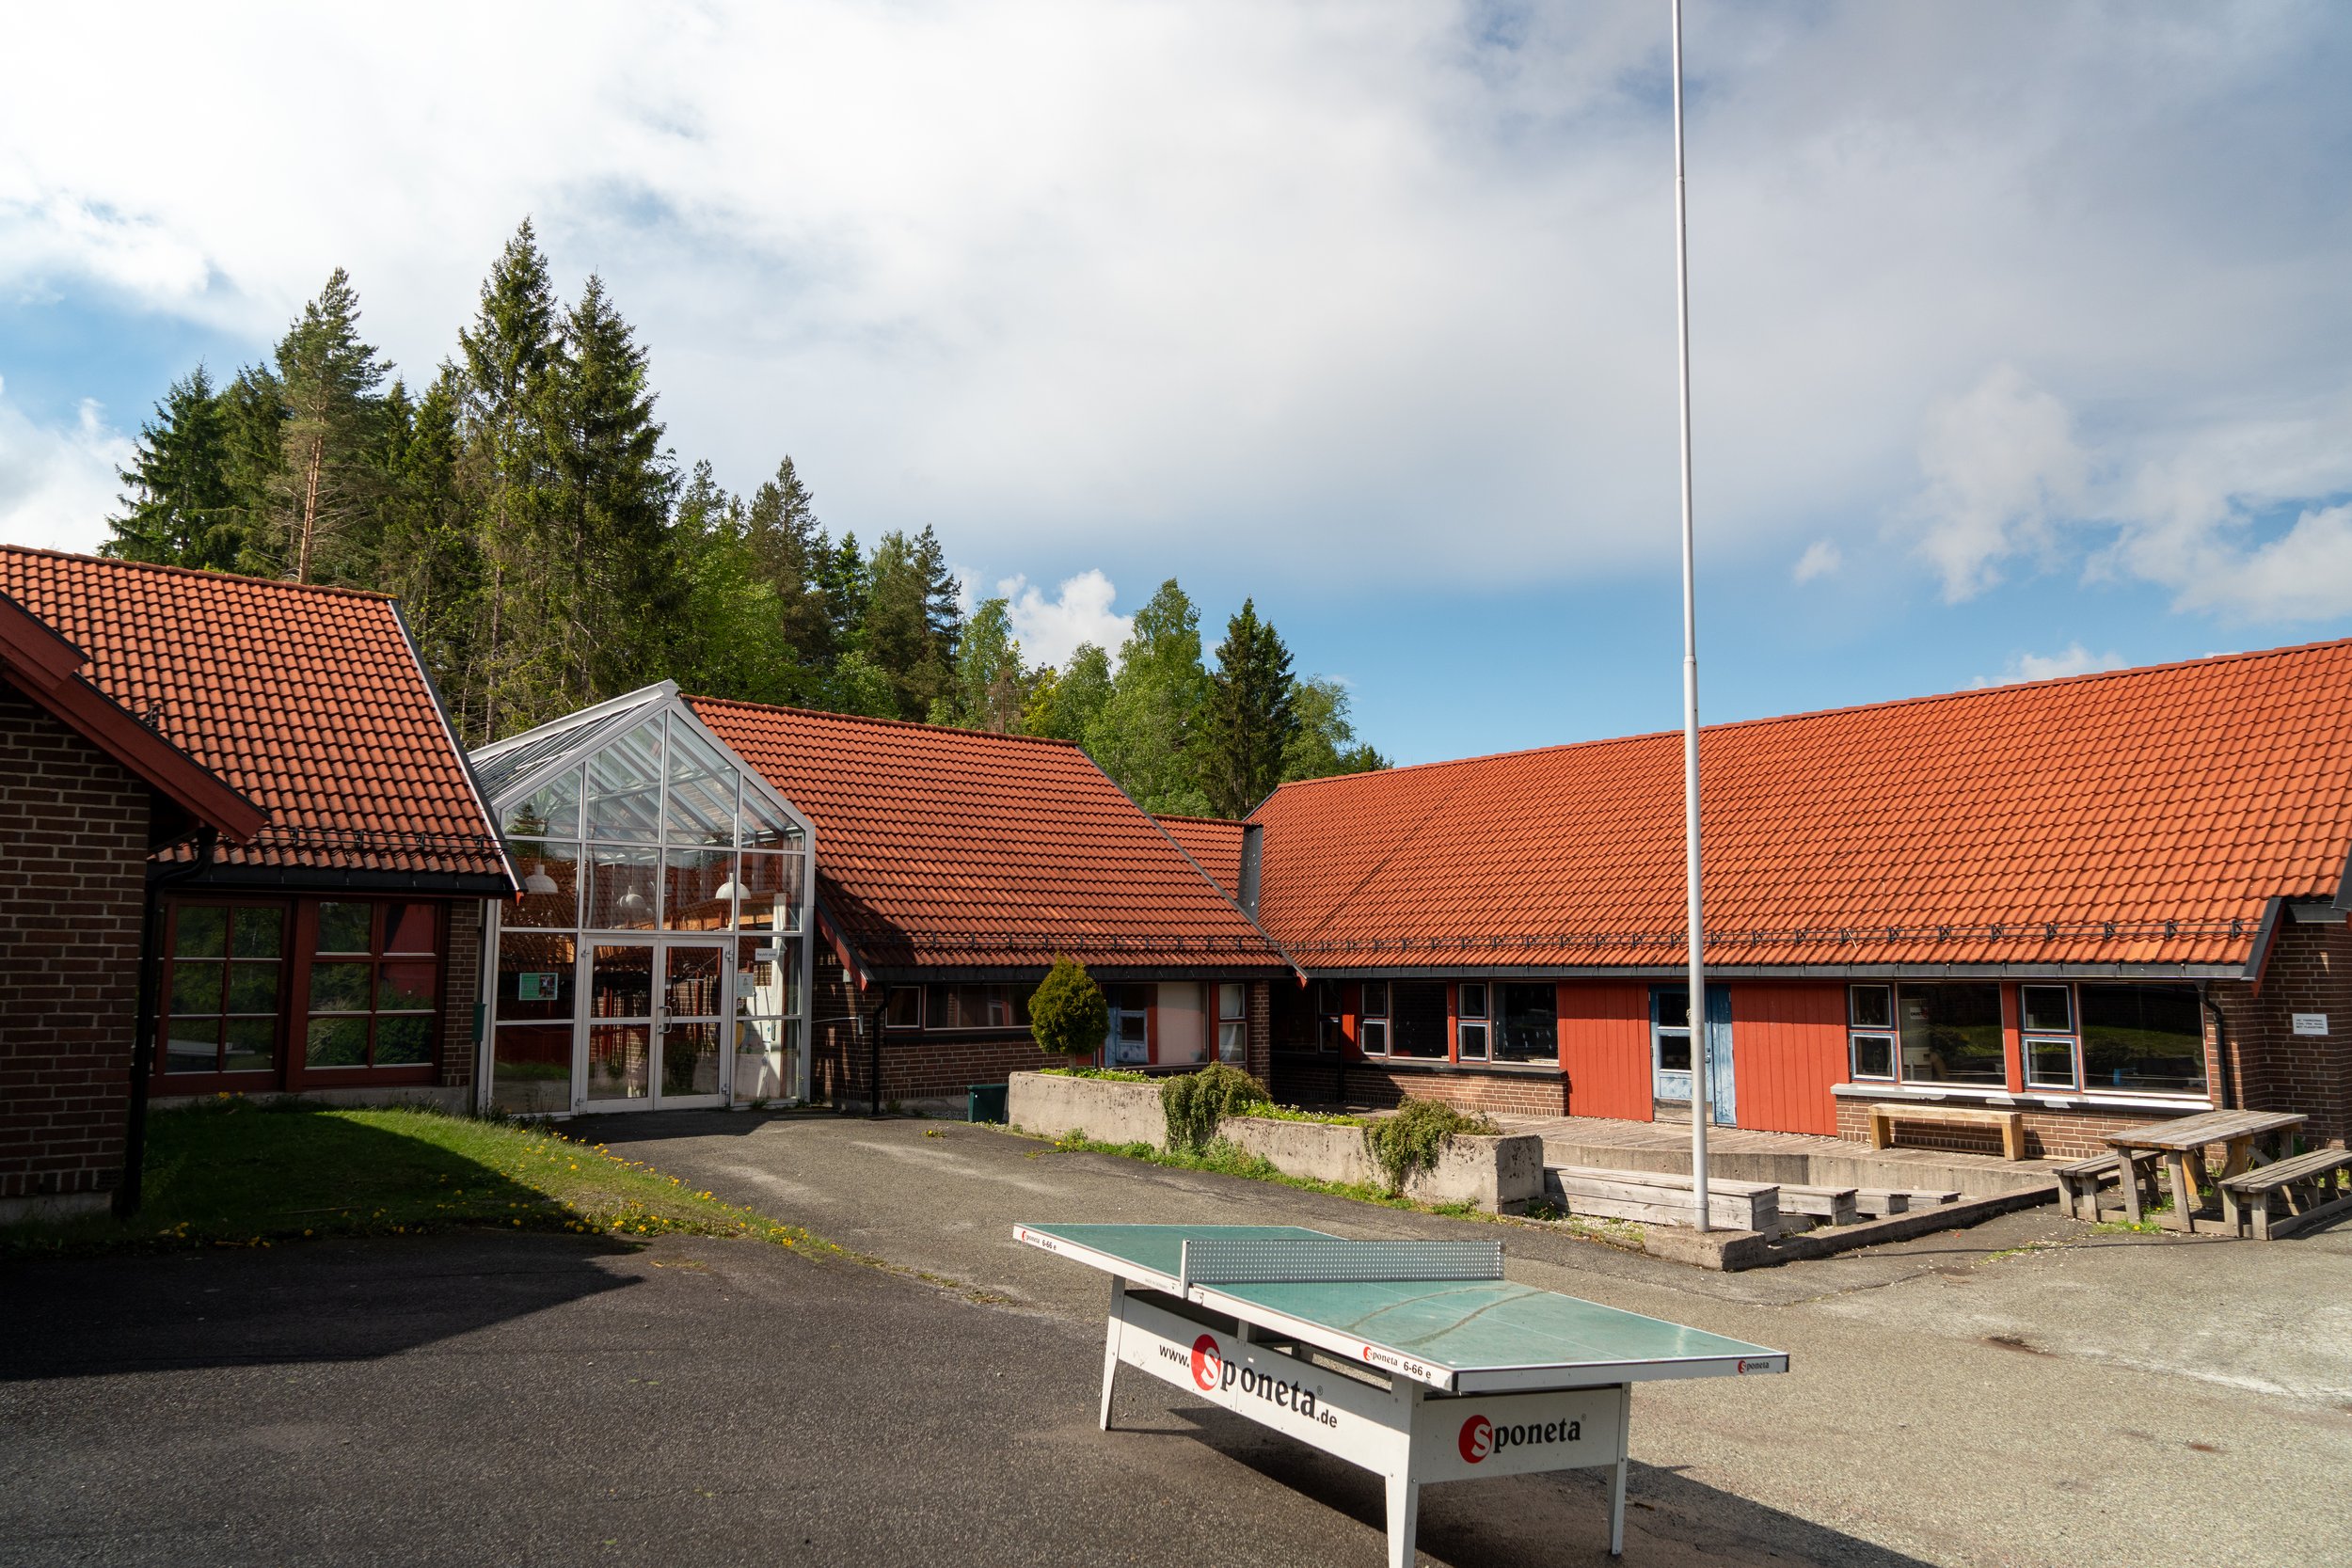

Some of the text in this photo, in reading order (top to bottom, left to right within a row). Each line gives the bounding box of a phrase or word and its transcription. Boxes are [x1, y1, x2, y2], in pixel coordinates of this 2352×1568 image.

[1364, 1347, 1432, 1379] Sponeta 6-66 e
[1740, 1360, 1770, 1373] Sponeta
[1466, 1417, 1581, 1459] Sponeta
